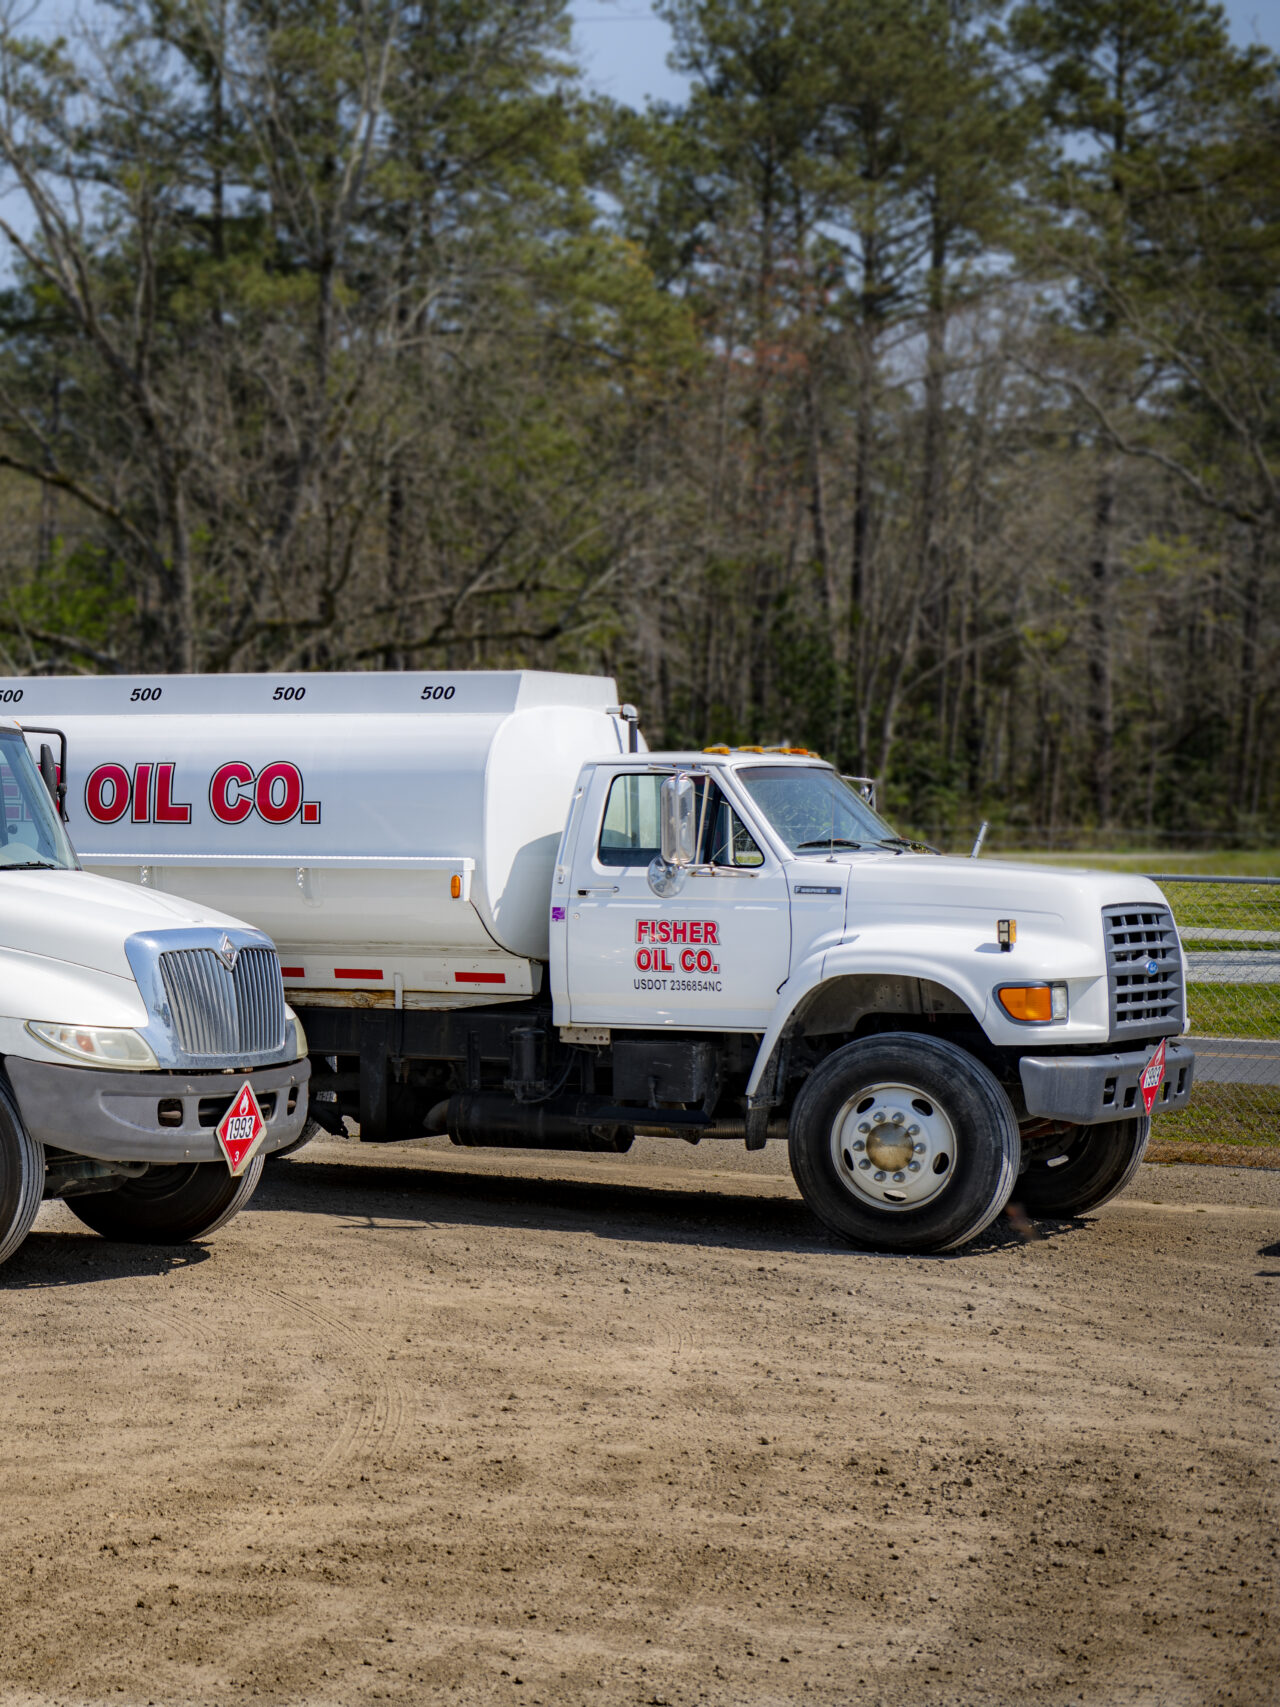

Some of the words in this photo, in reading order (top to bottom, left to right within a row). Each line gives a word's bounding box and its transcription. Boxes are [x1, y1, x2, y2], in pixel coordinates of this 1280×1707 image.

[130, 687, 162, 702] 500
[272, 687, 306, 701] 500
[420, 686, 456, 700] 500
[84, 762, 192, 824] OIL
[208, 761, 322, 825] CO.
[635, 919, 721, 946] FISHER
[635, 947, 675, 973] OIL
[679, 947, 720, 974] CO.
[633, 979, 667, 991] USDOT
[669, 980, 723, 993] 2356854NC
[229, 1116, 254, 1140] 1993
[234, 1150, 240, 1162] 3
